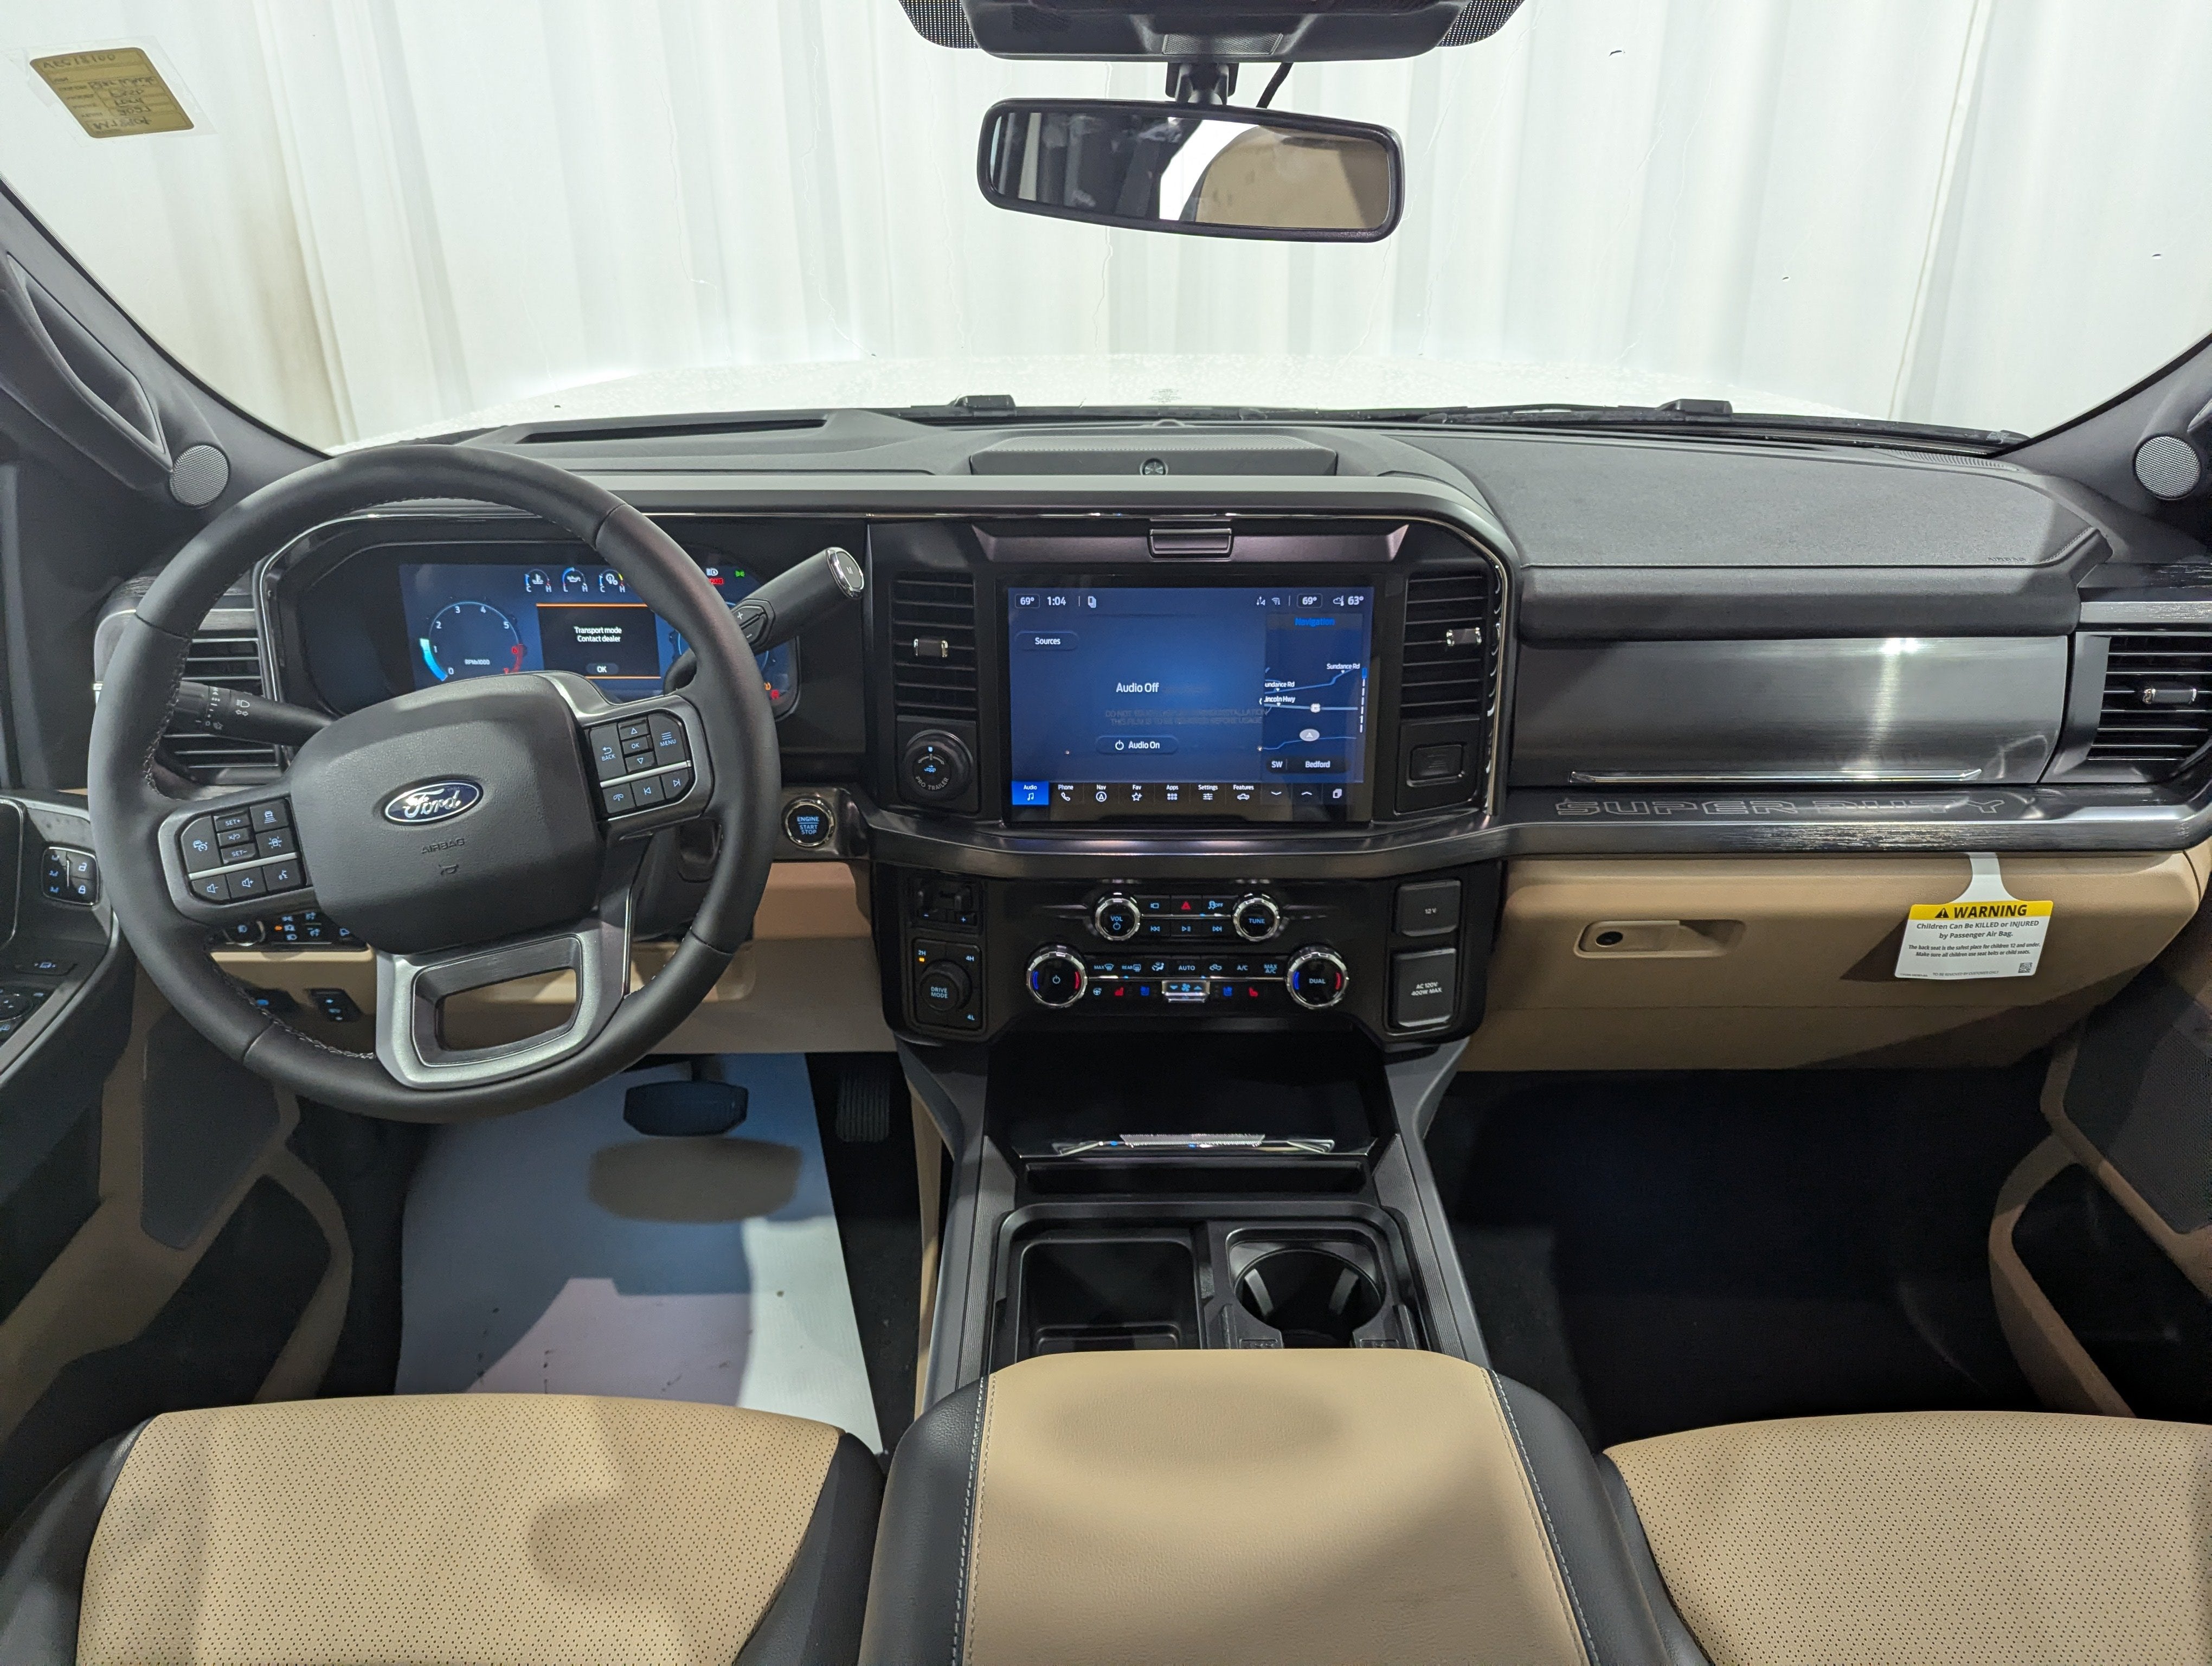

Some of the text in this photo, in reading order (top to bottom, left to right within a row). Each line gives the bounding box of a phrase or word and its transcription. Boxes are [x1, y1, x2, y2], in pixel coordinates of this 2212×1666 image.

[1047, 597, 1066, 605] 1:04
[1295, 618, 1335, 627] Navigation
[574, 626, 604, 635] Transport
[1116, 682, 1143, 693] Audio
[1144, 682, 1159, 693] Off
[1128, 741, 1148, 749] Audio
[915, 776, 949, 790] PRO TRAILER
[403, 788, 461, 818] Ford
[1555, 800, 1798, 815] SUPER
[421, 838, 465, 854] AIRBAG
[1954, 905, 2027, 918] WARNING
